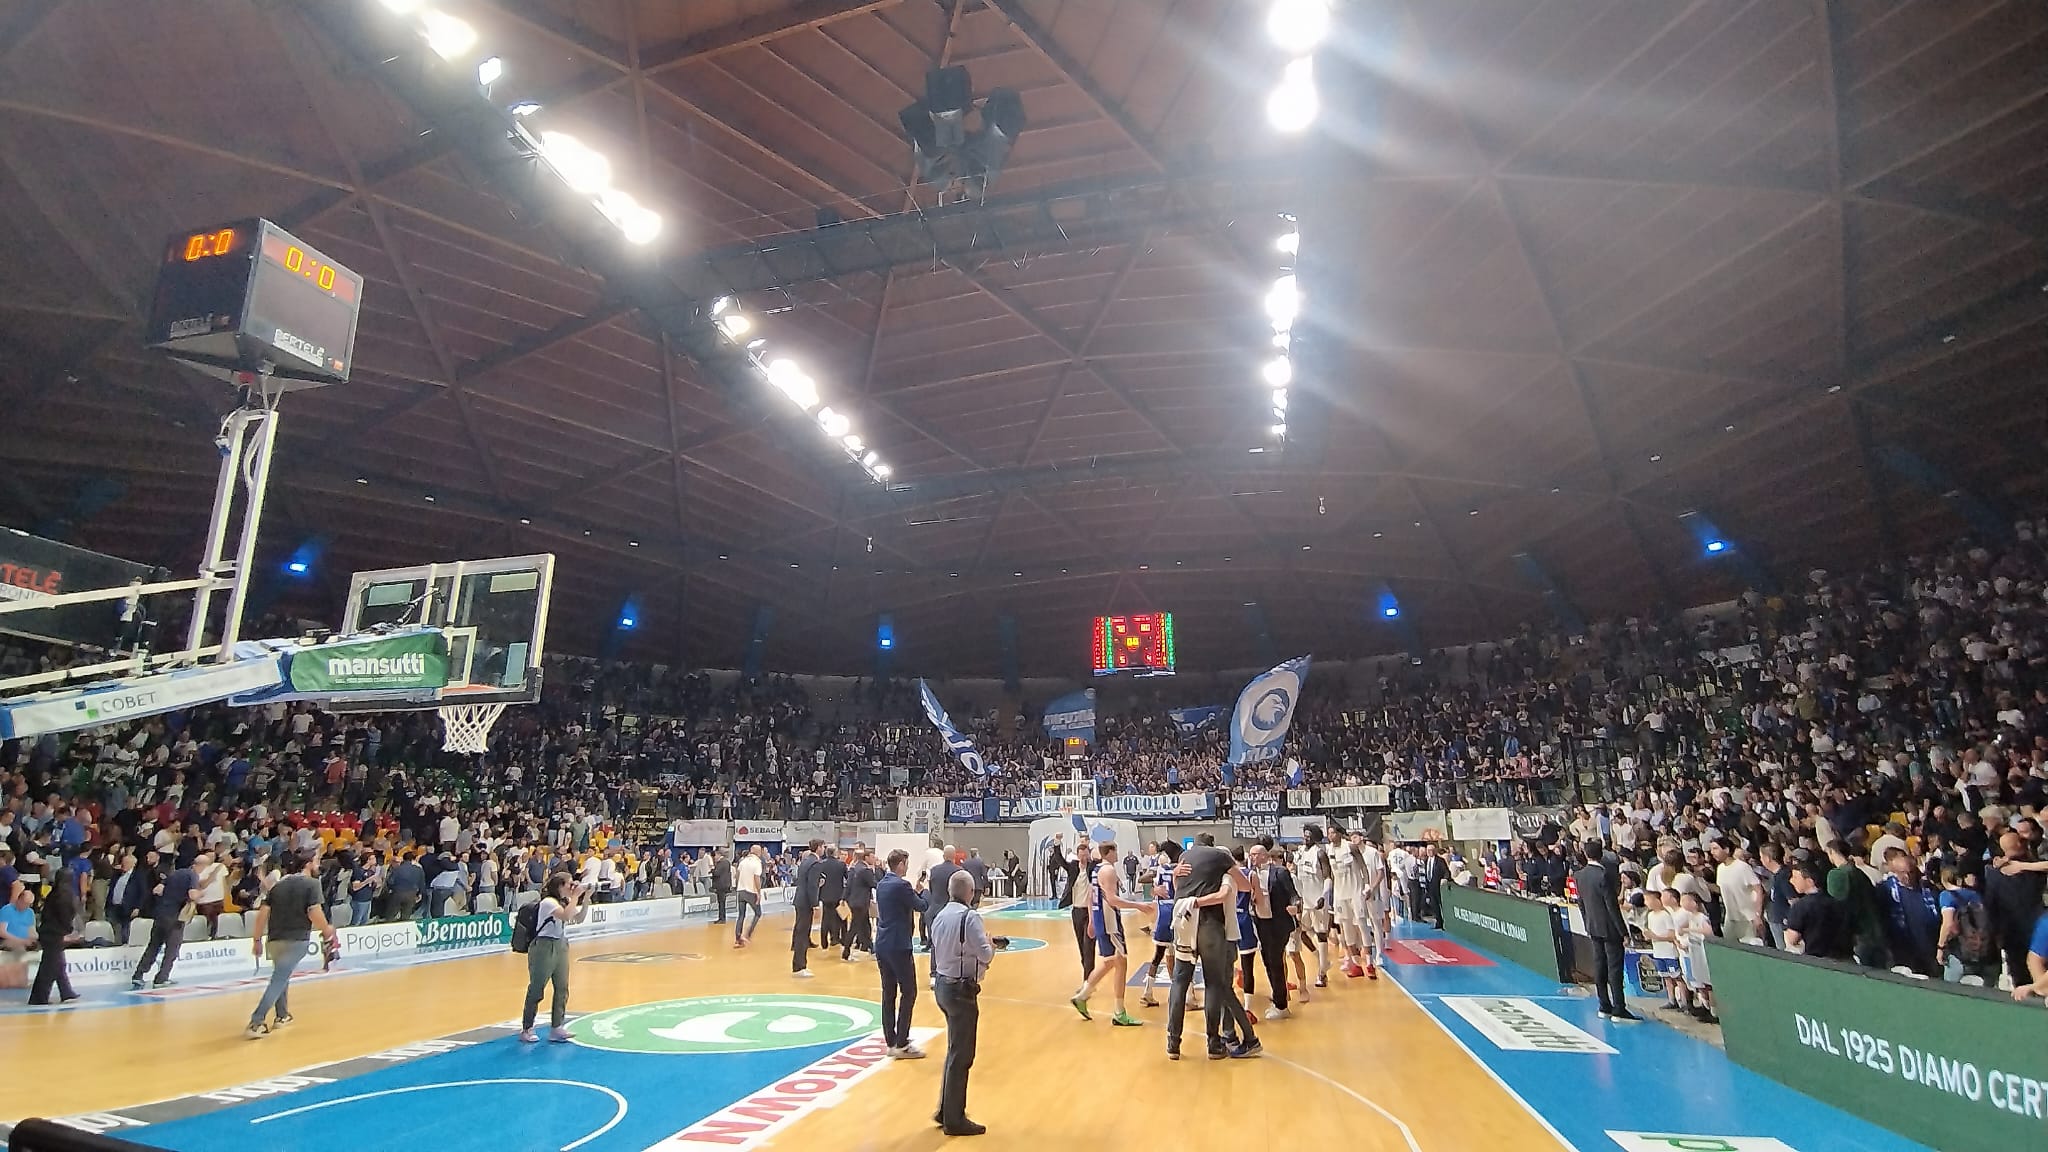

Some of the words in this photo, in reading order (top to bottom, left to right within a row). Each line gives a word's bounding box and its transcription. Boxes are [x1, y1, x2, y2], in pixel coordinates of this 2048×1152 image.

[185, 229, 235, 262] 0:0
[285, 246, 336, 290] 0:0
[328, 652, 425, 676] mansutti
[102, 692, 156, 714] COBET
[1232, 801, 1250, 812] DEL
[749, 827, 782, 835] SEBACH
[1234, 815, 1277, 827] EAGLES
[347, 925, 412, 958] Project
[196, 947, 237, 961] salute
[1794, 1012, 1841, 1056] DAL
[1840, 1027, 1895, 1074] 1925
[1897, 1043, 1983, 1102] DIAMO
